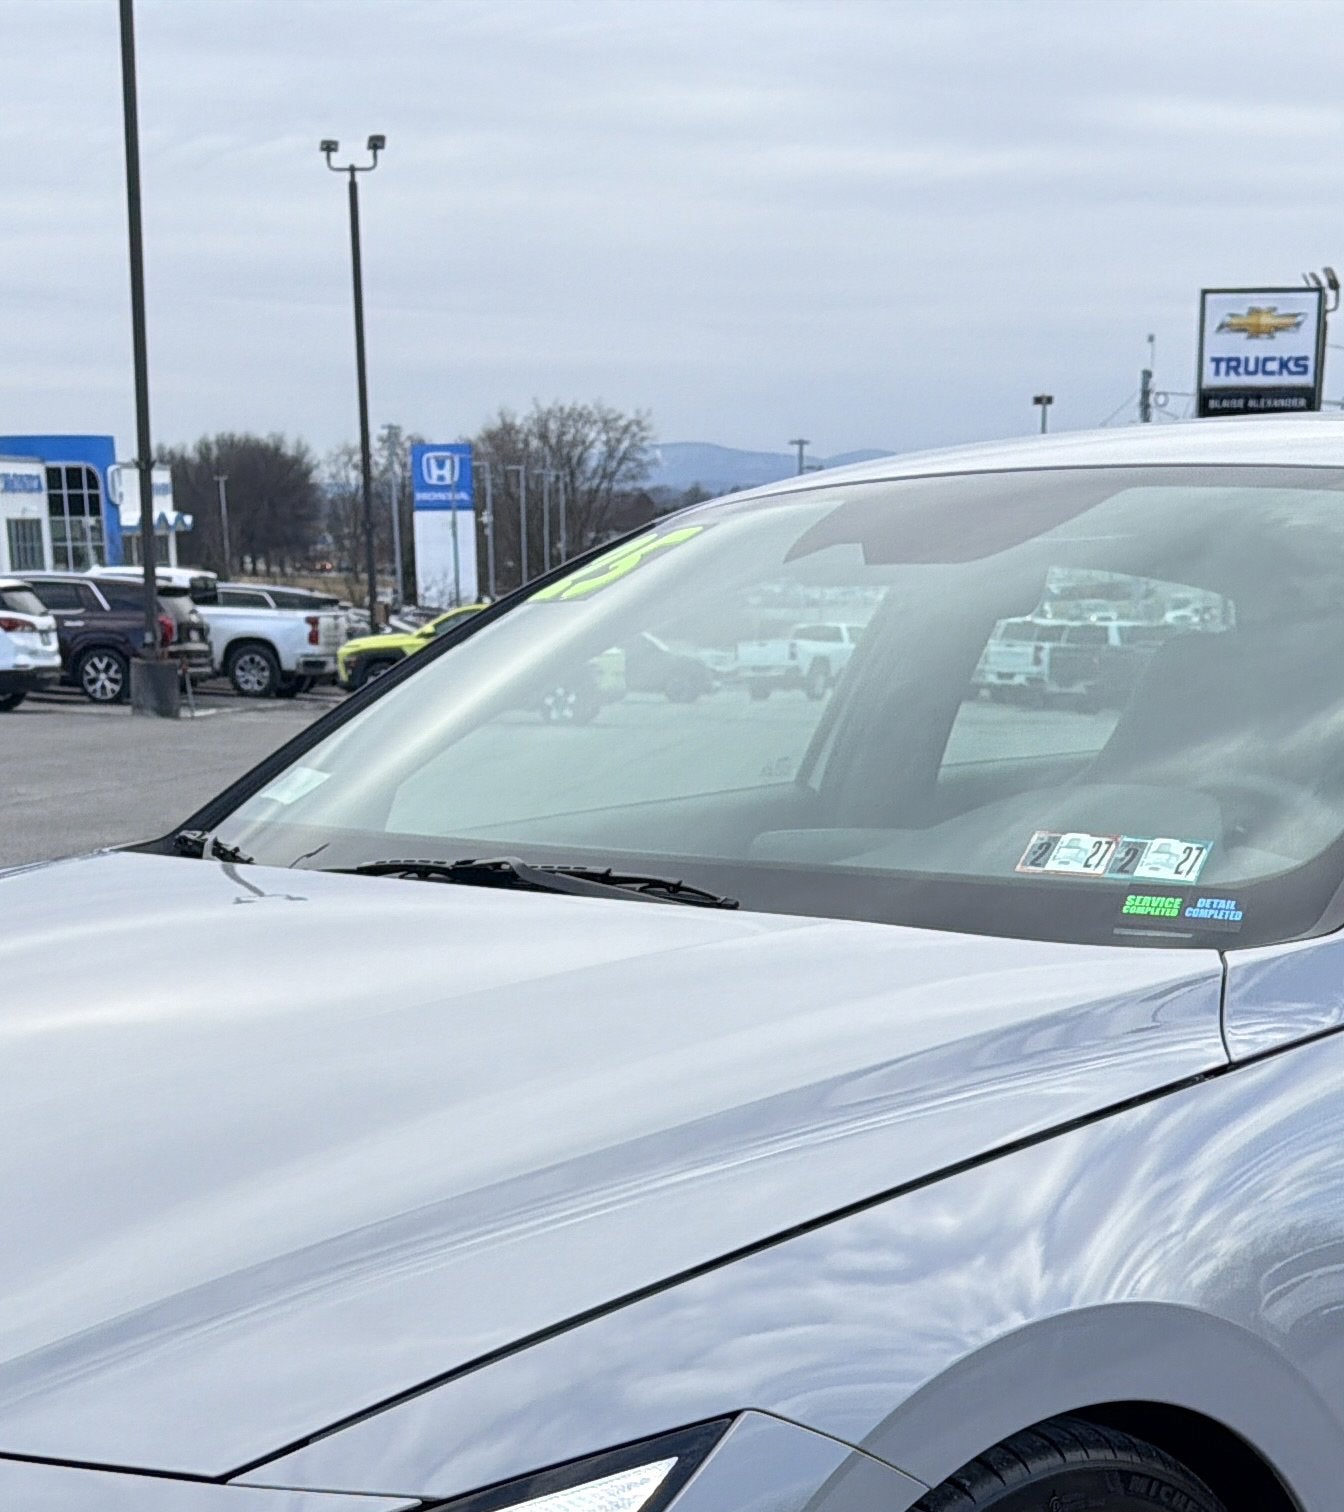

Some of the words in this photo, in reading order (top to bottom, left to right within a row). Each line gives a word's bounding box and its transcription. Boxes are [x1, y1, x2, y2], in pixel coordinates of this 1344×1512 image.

[1210, 355, 1309, 376] TRUCKS
[1030, 842, 1053, 867] 2
[1083, 840, 1113, 871] 27
[1118, 847, 1139, 875] 2
[1174, 846, 1204, 878] 27
[1126, 895, 1183, 909] SERVICE
[1197, 898, 1237, 909] DETAIL
[1122, 905, 1179, 917] COMPLETED
[1185, 907, 1243, 920] COMPLETED
